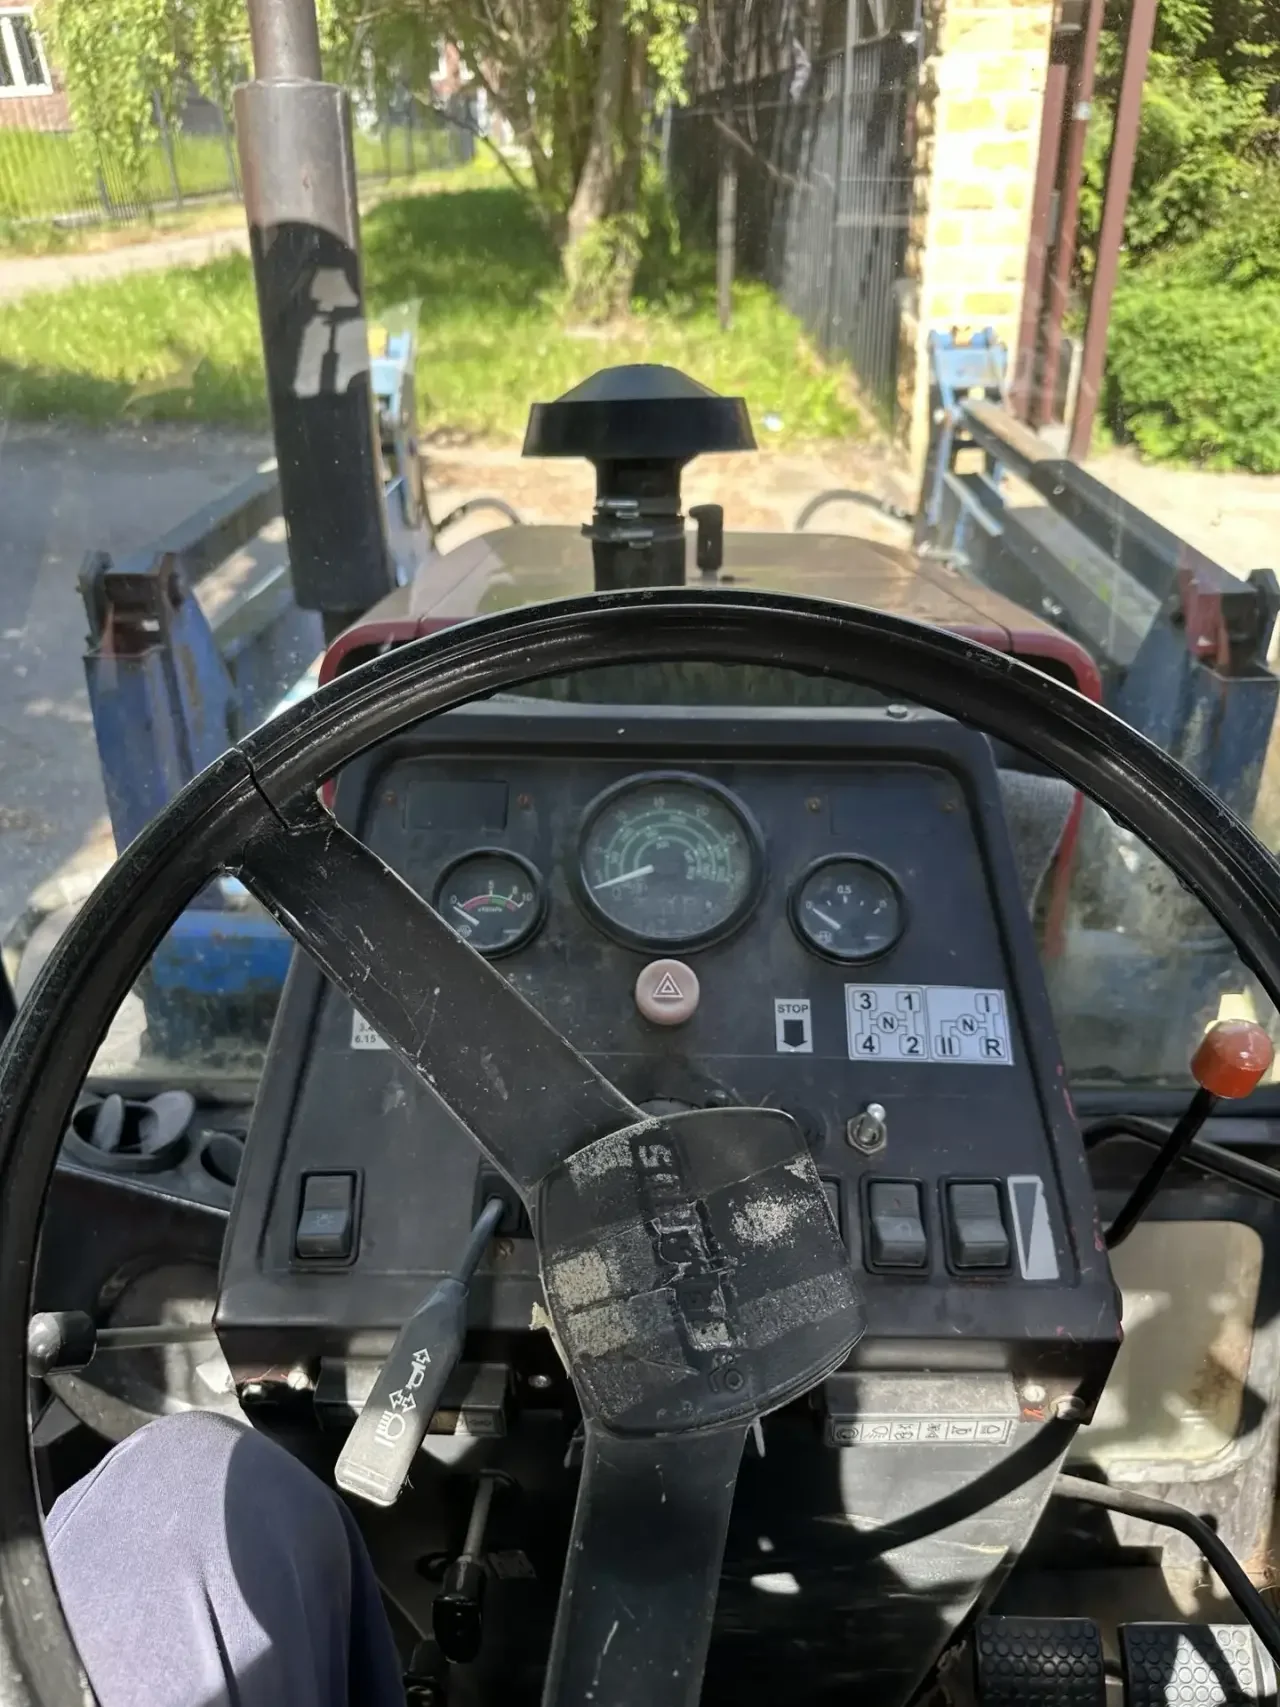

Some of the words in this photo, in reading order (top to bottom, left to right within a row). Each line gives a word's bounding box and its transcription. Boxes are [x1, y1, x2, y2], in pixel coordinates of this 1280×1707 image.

[777, 1004, 809, 1014] STOP
[860, 993, 872, 1010] 3
[903, 994, 913, 1010] 1
[883, 1017, 894, 1029] N
[962, 1019, 974, 1031] N
[862, 1036, 875, 1052] 4
[907, 1037, 919, 1053] 2
[986, 1039, 1001, 1056] R
